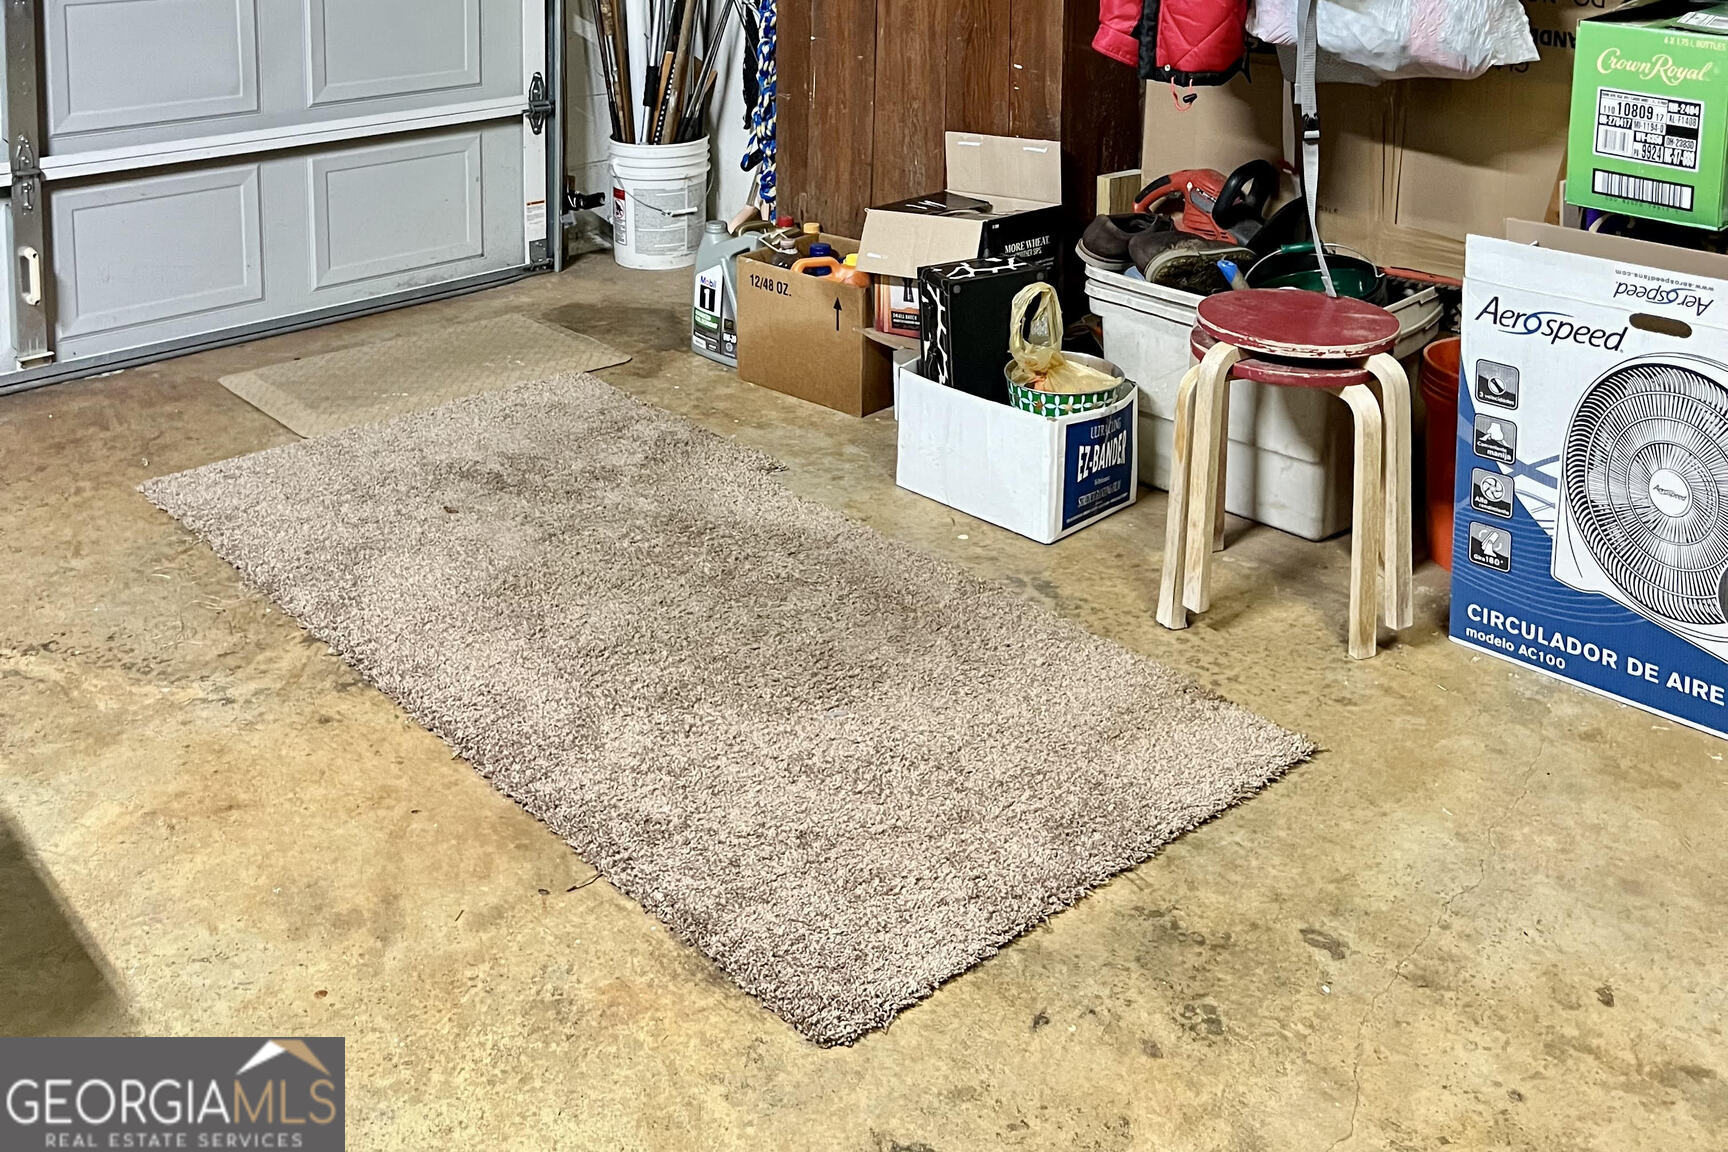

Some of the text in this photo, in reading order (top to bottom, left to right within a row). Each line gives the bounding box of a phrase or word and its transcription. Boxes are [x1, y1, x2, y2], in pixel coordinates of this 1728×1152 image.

[1695, 40, 1727, 51] BOTTLES
[1597, 48, 1712, 86] Crown Royal
[1618, 101, 1654, 120] 10809
[1641, 144, 1662, 162] 9924
[1004, 235, 1050, 254] MORE WHEAT
[700, 275, 716, 288] Mobil
[750, 274, 792, 297] 12/48 OZ.
[1615, 269, 1715, 291] www.aerospeedfans.com
[1613, 281, 1714, 316] Aerospeed
[1475, 296, 1629, 352] Aerospeed
[1077, 430, 1127, 483] EZ-BANDER
[1487, 449, 1512, 461] manija
[1465, 626, 1566, 670] modelo AC100
[1467, 603, 1726, 707] CIRCULADOR DE AIRE
